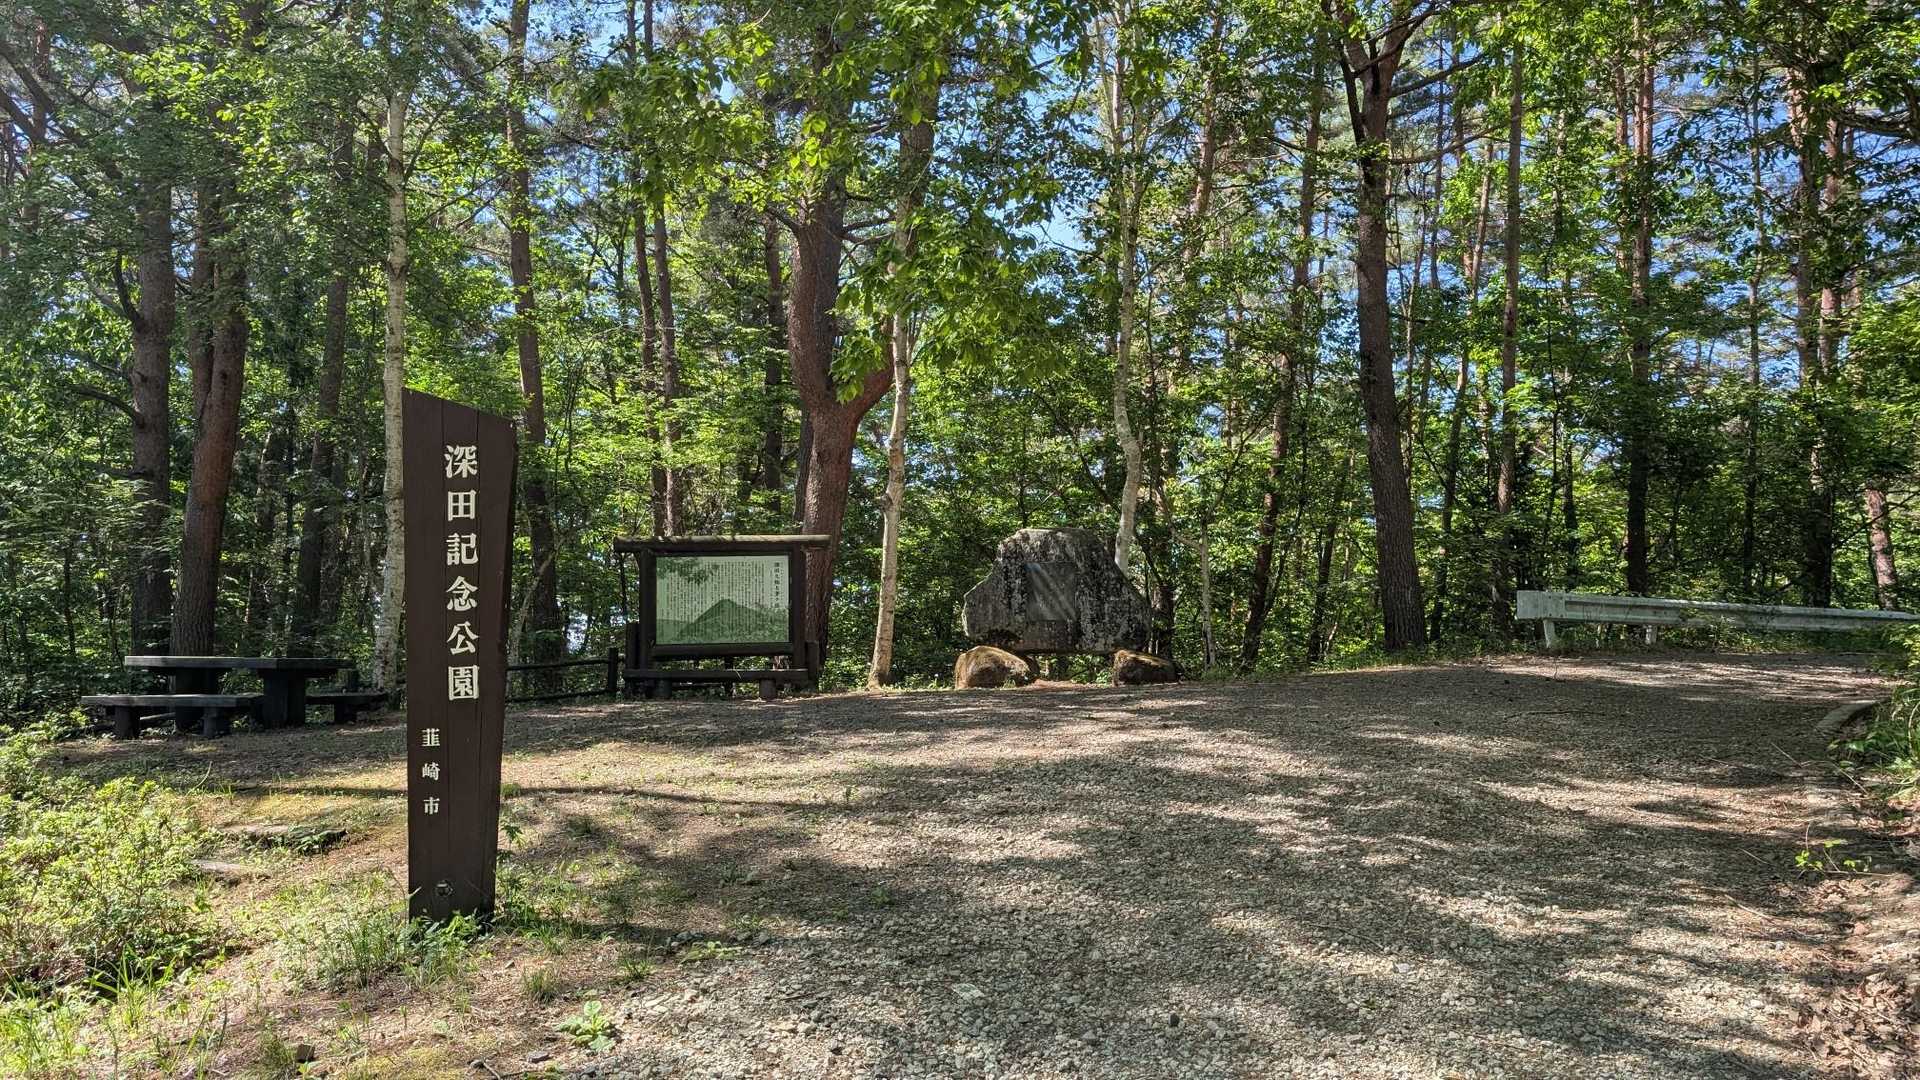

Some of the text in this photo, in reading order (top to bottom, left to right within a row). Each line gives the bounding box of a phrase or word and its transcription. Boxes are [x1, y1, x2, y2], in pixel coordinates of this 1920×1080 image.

[444, 446, 480, 701] 深田記念公園
[422, 728, 440, 815] 韮崎市
